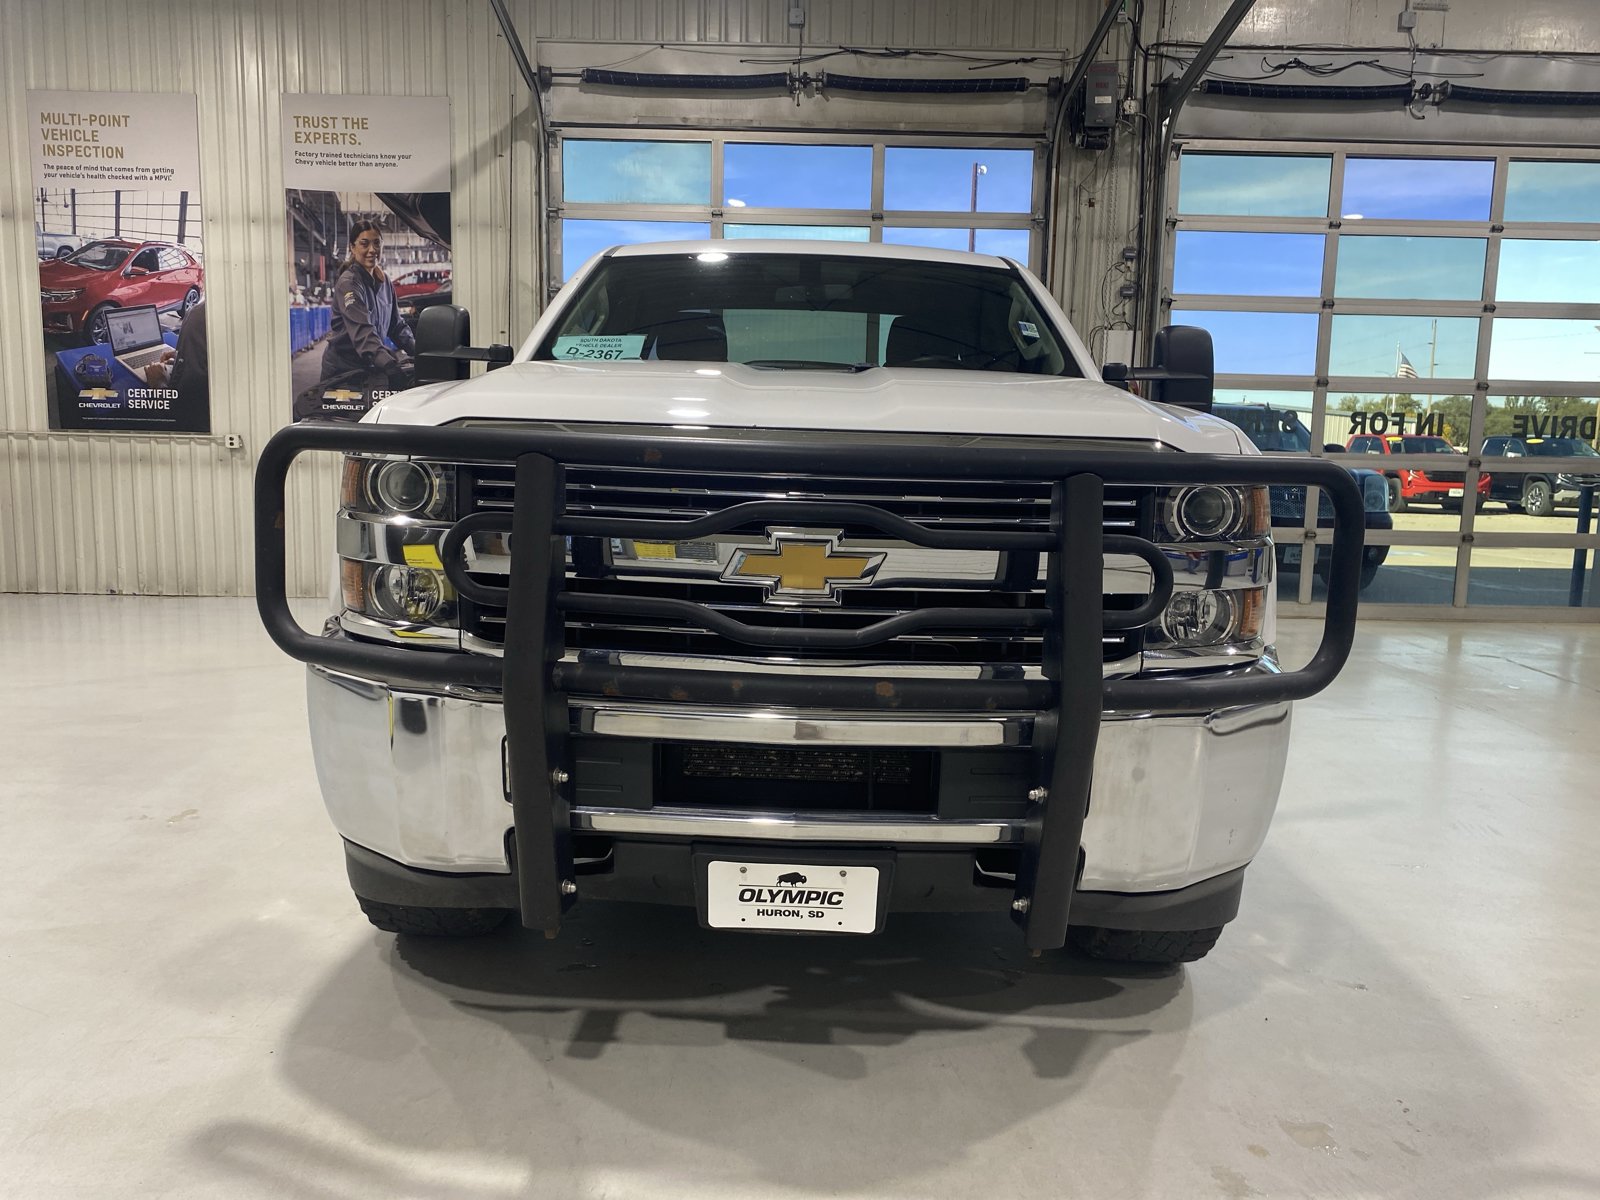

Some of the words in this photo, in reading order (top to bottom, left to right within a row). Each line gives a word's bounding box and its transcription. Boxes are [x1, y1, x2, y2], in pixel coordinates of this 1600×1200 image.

[40, 112, 130, 128] MULTI-POINT
[293, 116, 338, 129] TRUST
[342, 117, 369, 130] THE
[41, 128, 100, 142] VEHICLE
[294, 132, 362, 145] EXPERTS.
[42, 144, 124, 159] INSPECTION
[294, 150, 318, 159] Factory
[566, 346, 624, 360] D-2367
[128, 388, 178, 399] CERTIFIED
[128, 400, 170, 410] SERVICE
[738, 888, 844, 906] OLYMPIC
[756, 908, 804, 919] HURON,
[808, 910, 824, 918] SD
